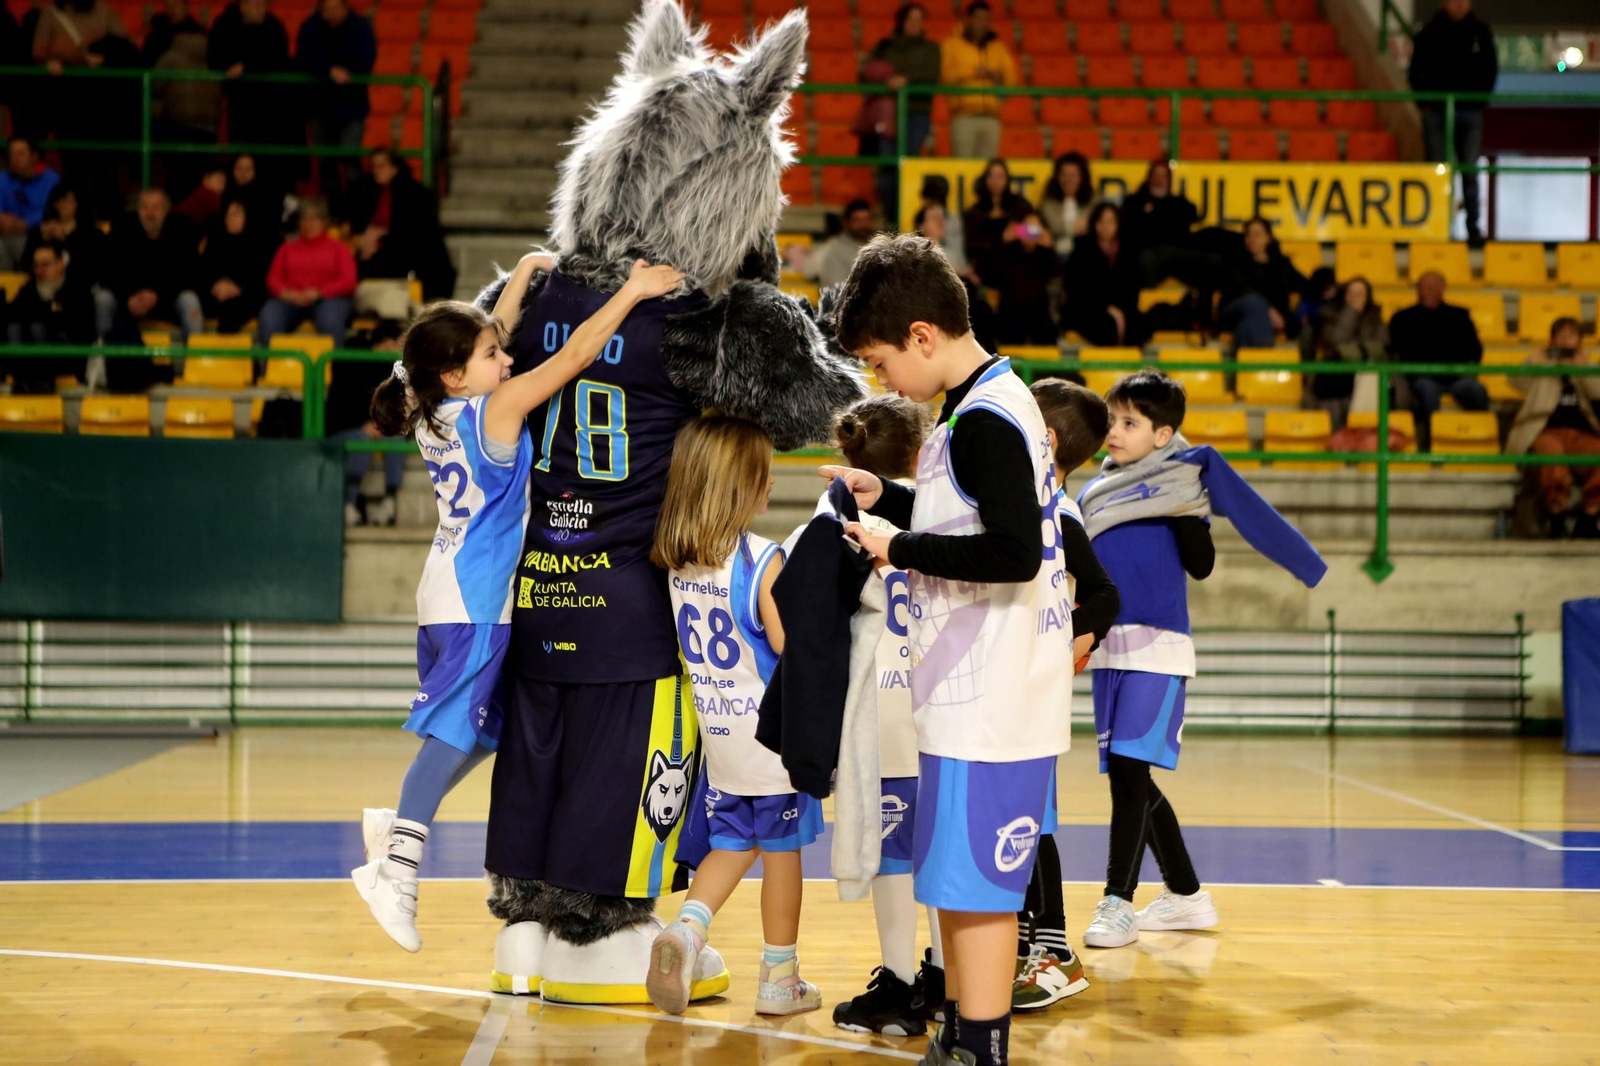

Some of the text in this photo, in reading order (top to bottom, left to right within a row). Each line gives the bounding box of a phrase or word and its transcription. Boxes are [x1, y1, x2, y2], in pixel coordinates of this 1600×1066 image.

[550, 511, 588, 529] Galicia
[534, 582, 577, 594] XUNTA
[534, 595, 607, 608] DE GALICIA
[677, 603, 741, 670] 68
[554, 641, 577, 651] WIBO
